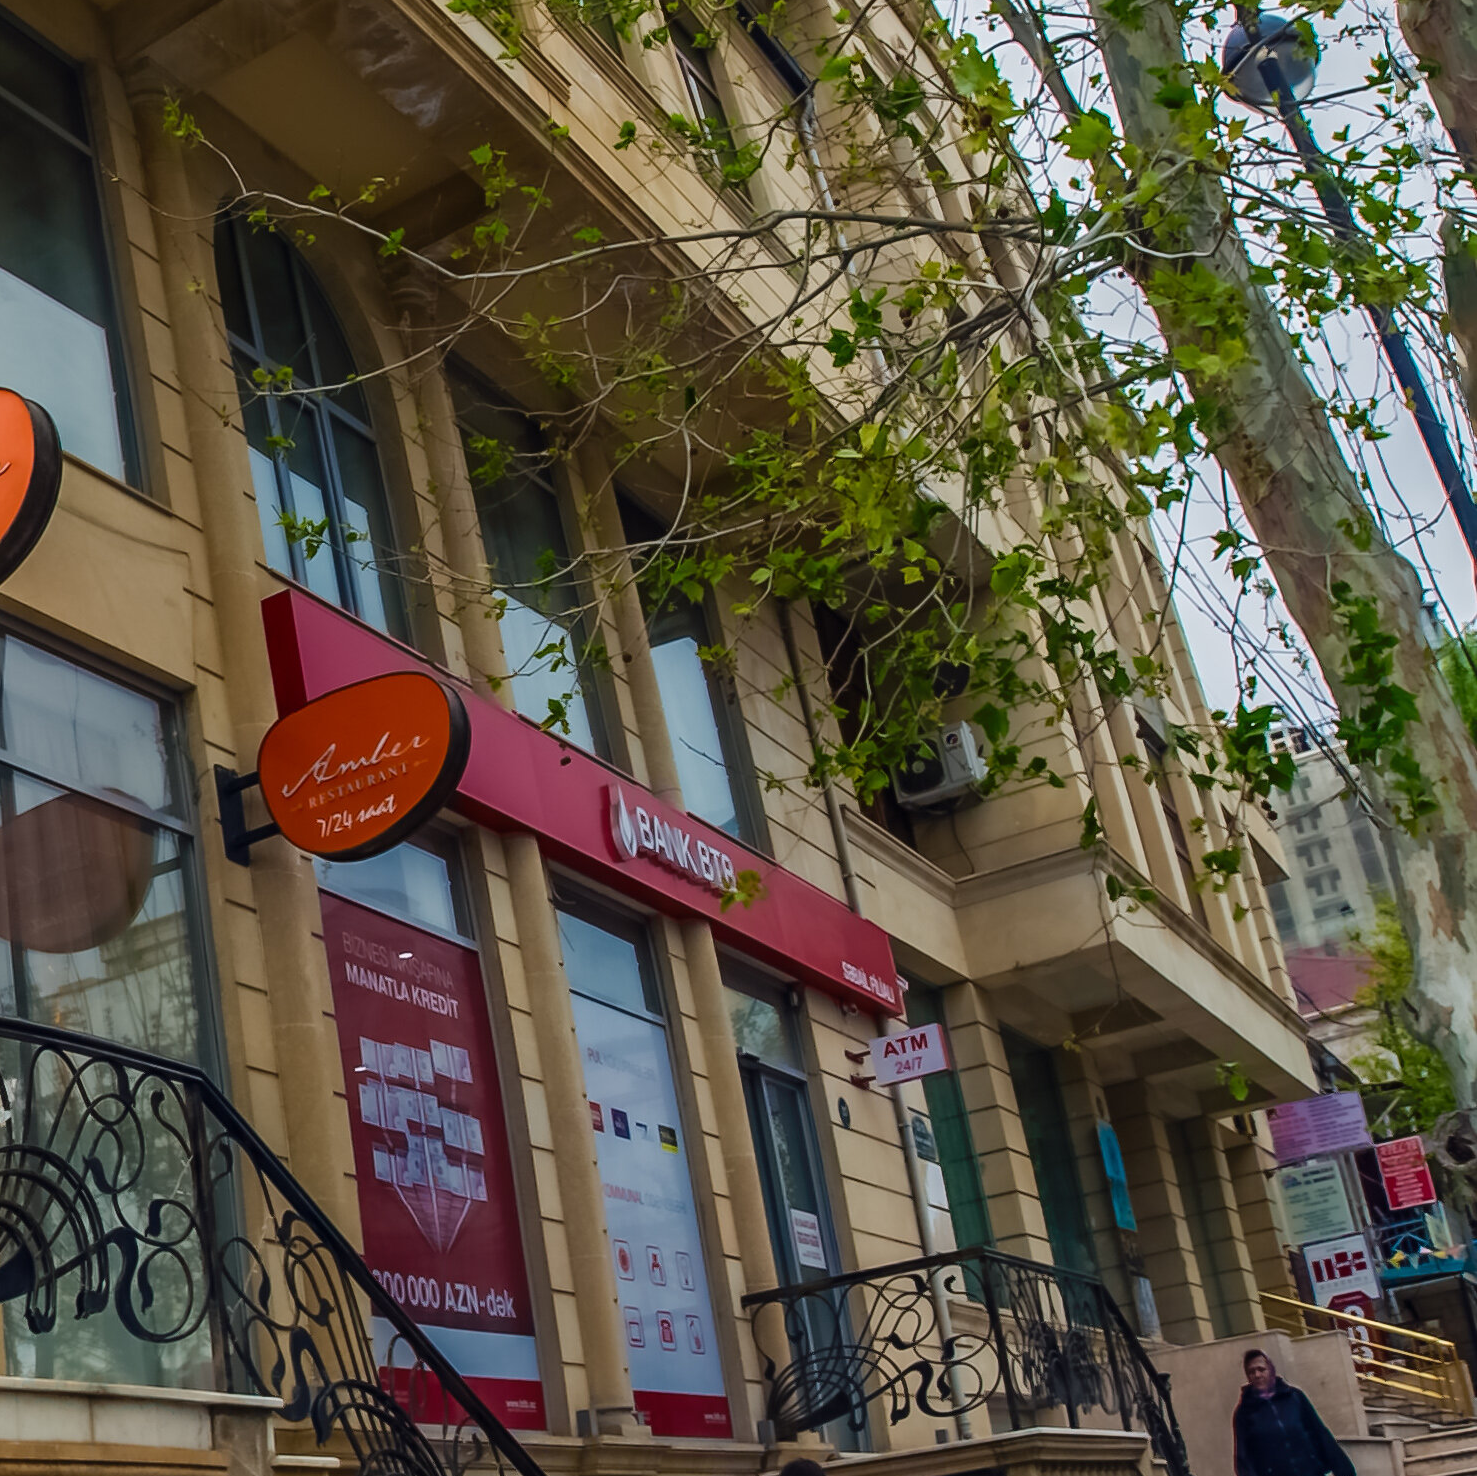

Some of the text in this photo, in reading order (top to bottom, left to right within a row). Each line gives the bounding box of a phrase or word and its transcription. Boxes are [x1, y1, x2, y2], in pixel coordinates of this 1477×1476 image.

[281, 731, 430, 798] Amber
[308, 762, 408, 809] RESTAURANT
[317, 794, 397, 838] 7/24 saat
[636, 806, 699, 876] BANK
[345, 961, 459, 1020] MANATLA KREDİT
[883, 1032, 928, 1059] ATM
[894, 1056, 923, 1074] 24/7
[407, 1275, 441, 1310] 000
[445, 1282, 517, 1319] AZN-dək
